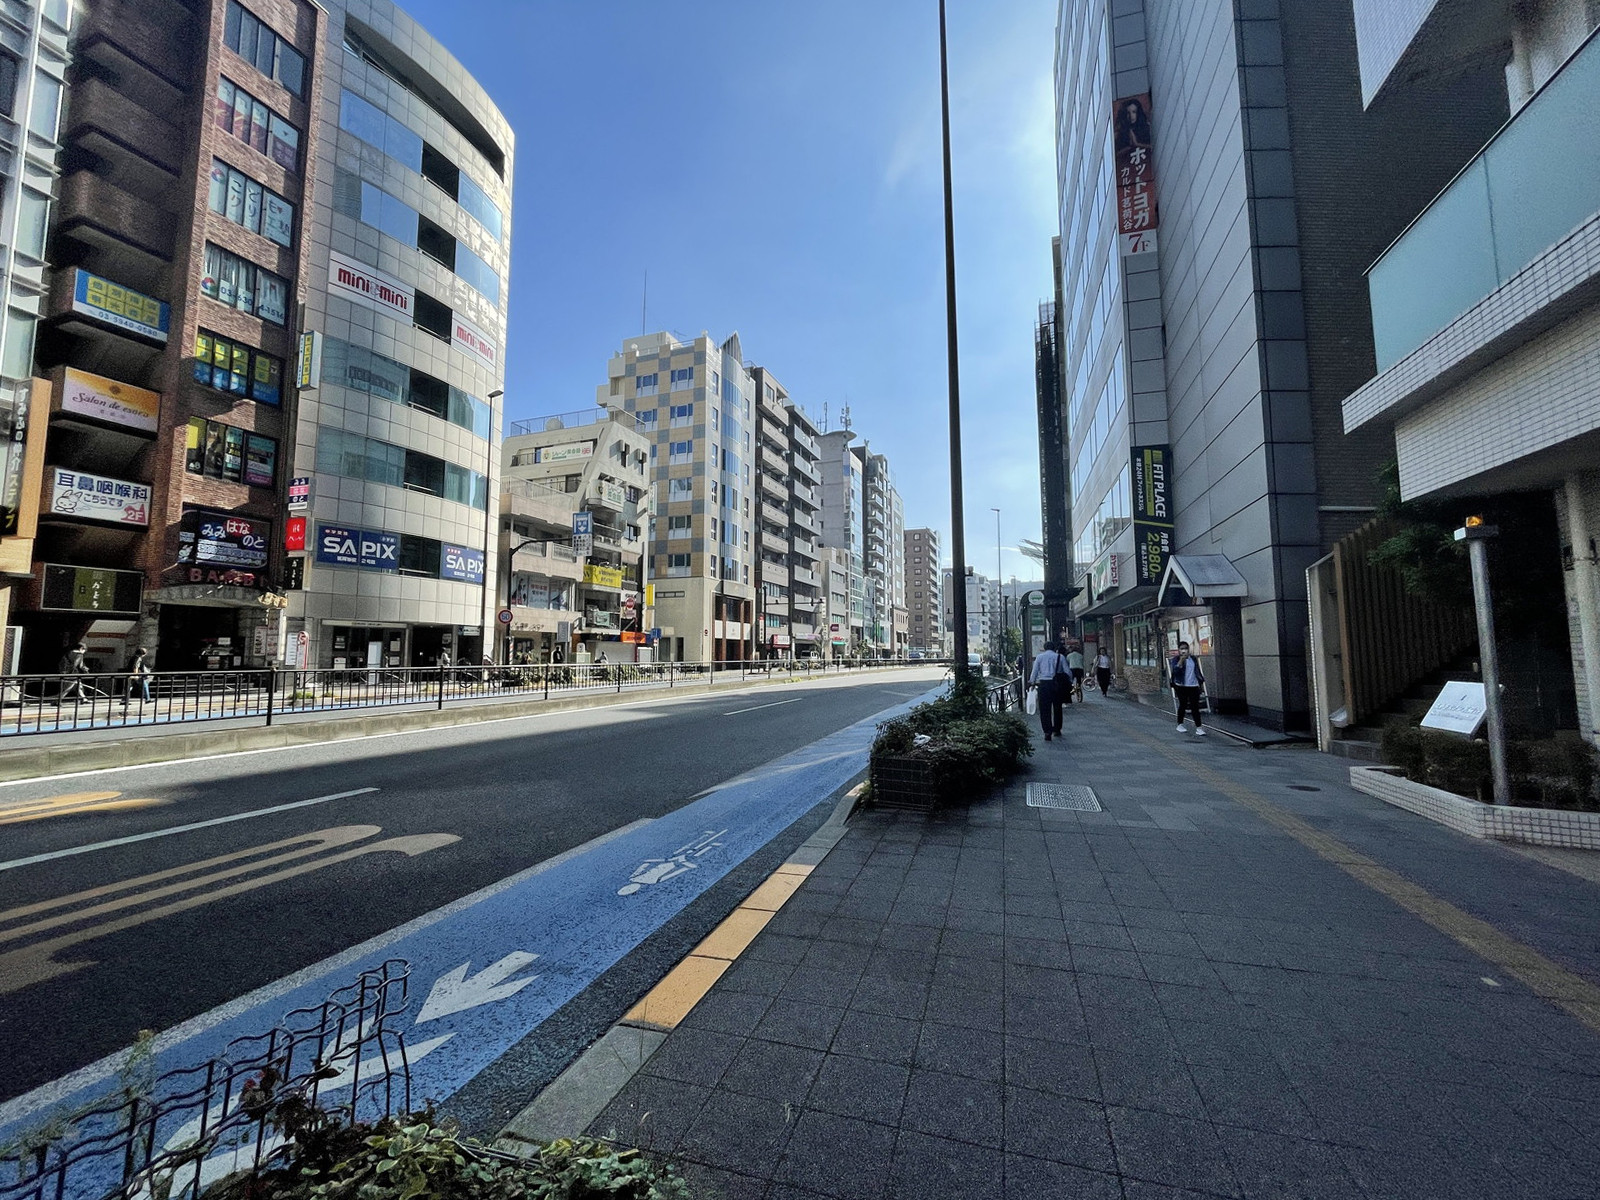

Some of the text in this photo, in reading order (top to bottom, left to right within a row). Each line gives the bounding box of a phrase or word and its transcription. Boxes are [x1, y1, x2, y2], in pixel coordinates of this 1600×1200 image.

[1130, 147, 1150, 230] ホットヨガ
[1128, 233, 1151, 254] 7F
[338, 267, 407, 310] mini mini
[456, 325, 475, 347] mini
[72, 392, 107, 407] Salon
[109, 401, 121, 410] de
[57, 472, 148, 502] 耳鼻咽喉科
[1153, 463, 1166, 518] FIT PLACE
[84, 493, 125, 507] こちらです
[127, 509, 144, 520] 2F
[201, 524, 227, 539] みみ
[226, 519, 250, 535] はな
[323, 536, 396, 560] SAPIX
[1110, 554, 1118, 584] サイゼリヤ
